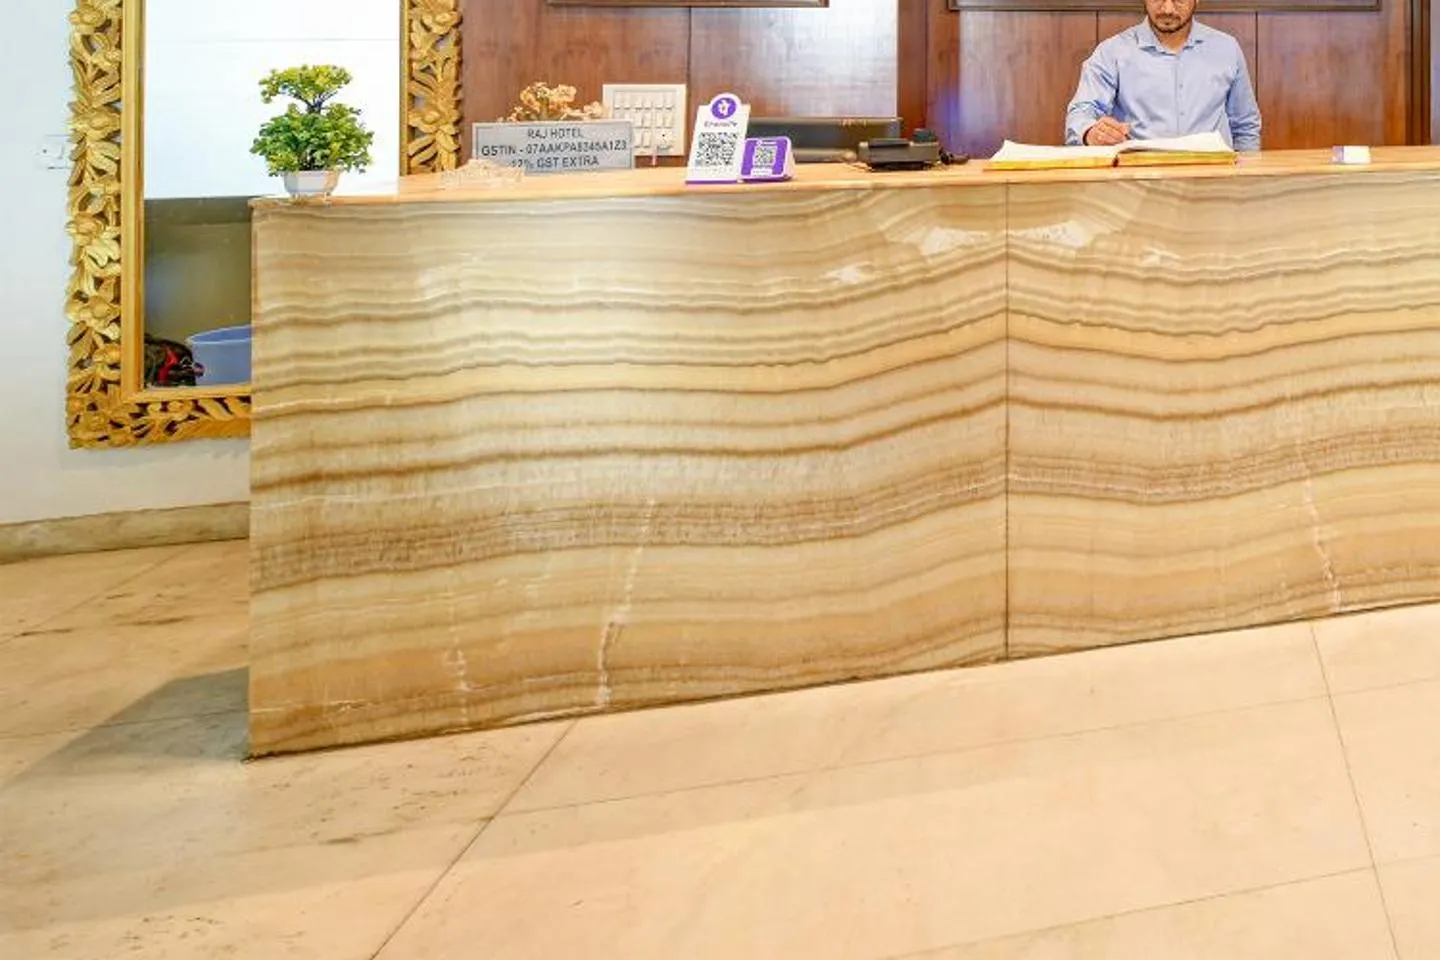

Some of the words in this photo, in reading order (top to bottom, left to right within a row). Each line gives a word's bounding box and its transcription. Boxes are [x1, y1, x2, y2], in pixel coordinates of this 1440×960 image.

[528, 128, 548, 139] RAJ
[550, 127, 584, 139] HOTEL
[481, 145, 516, 156] GSTIN
[537, 156, 559, 168] GST
[562, 155, 600, 168] EXTRA
